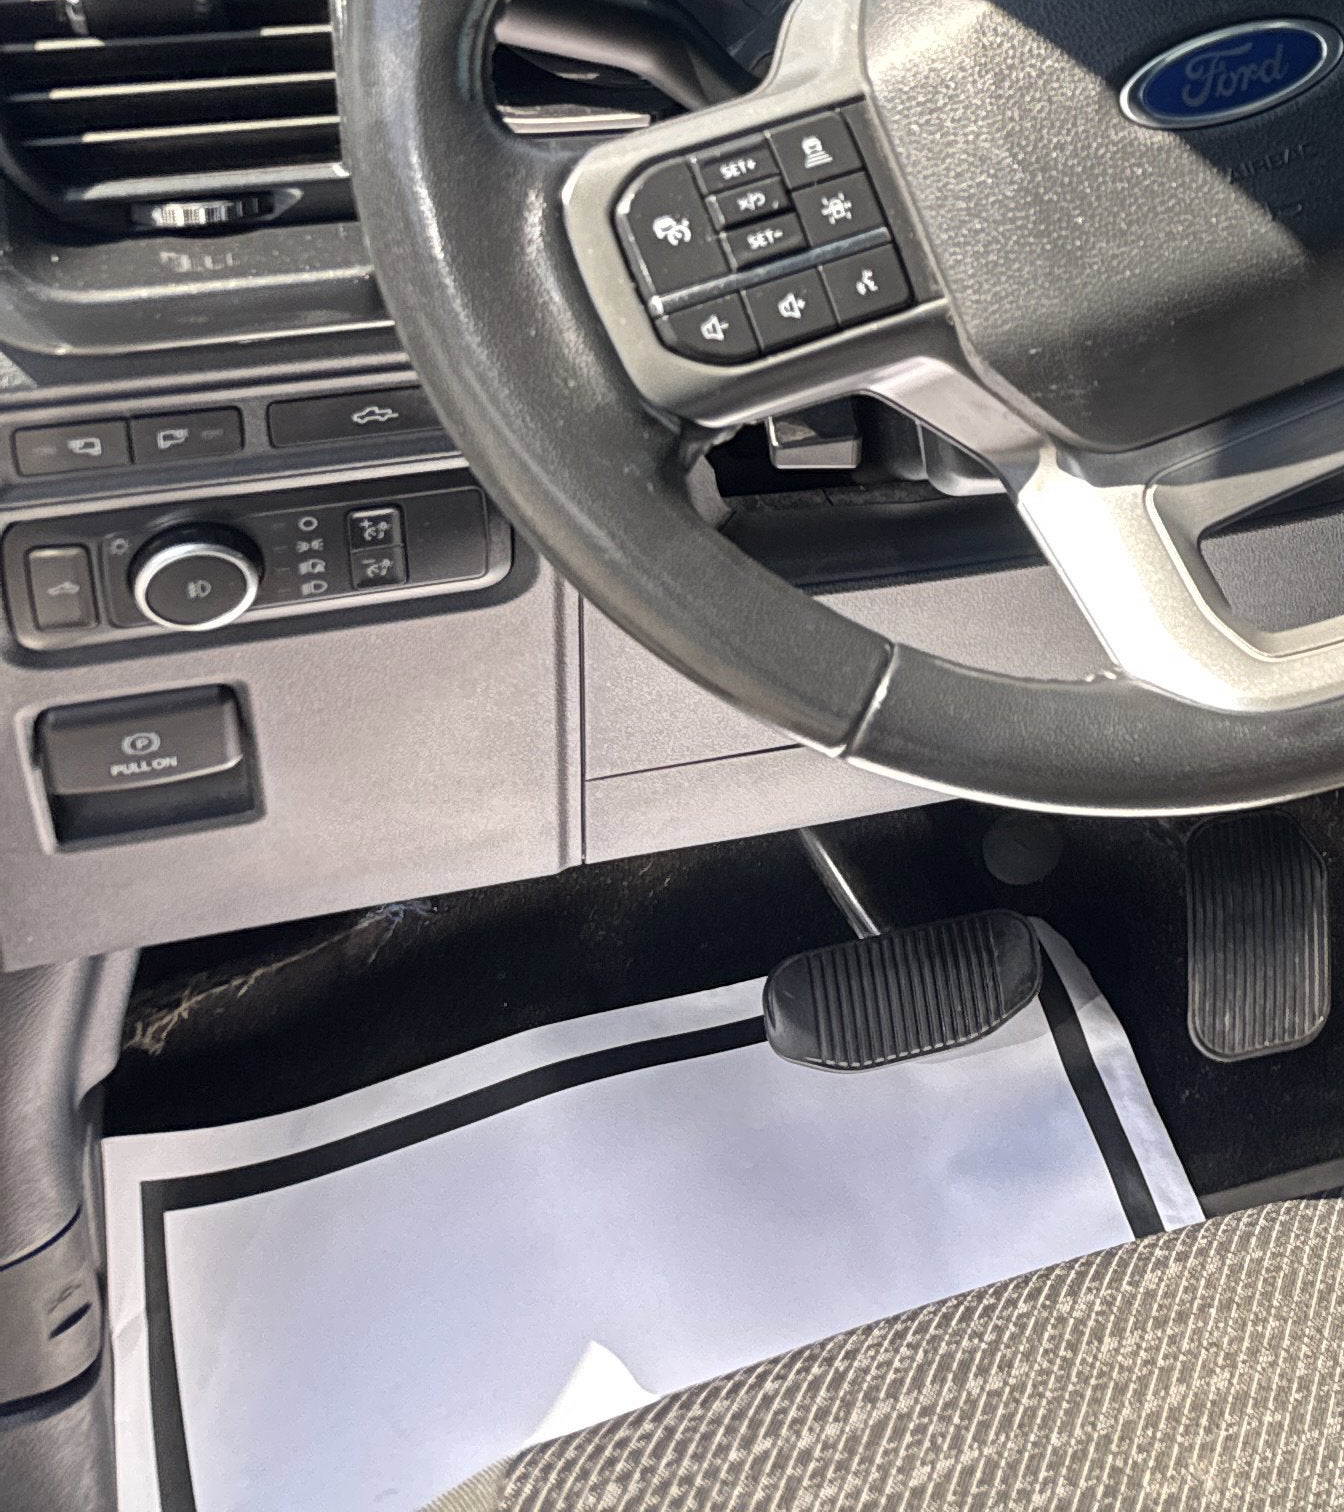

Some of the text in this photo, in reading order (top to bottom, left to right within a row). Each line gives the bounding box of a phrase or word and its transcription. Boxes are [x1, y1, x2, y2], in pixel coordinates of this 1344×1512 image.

[1181, 42, 1289, 108] Ford
[110, 756, 178, 776] PULL ON
